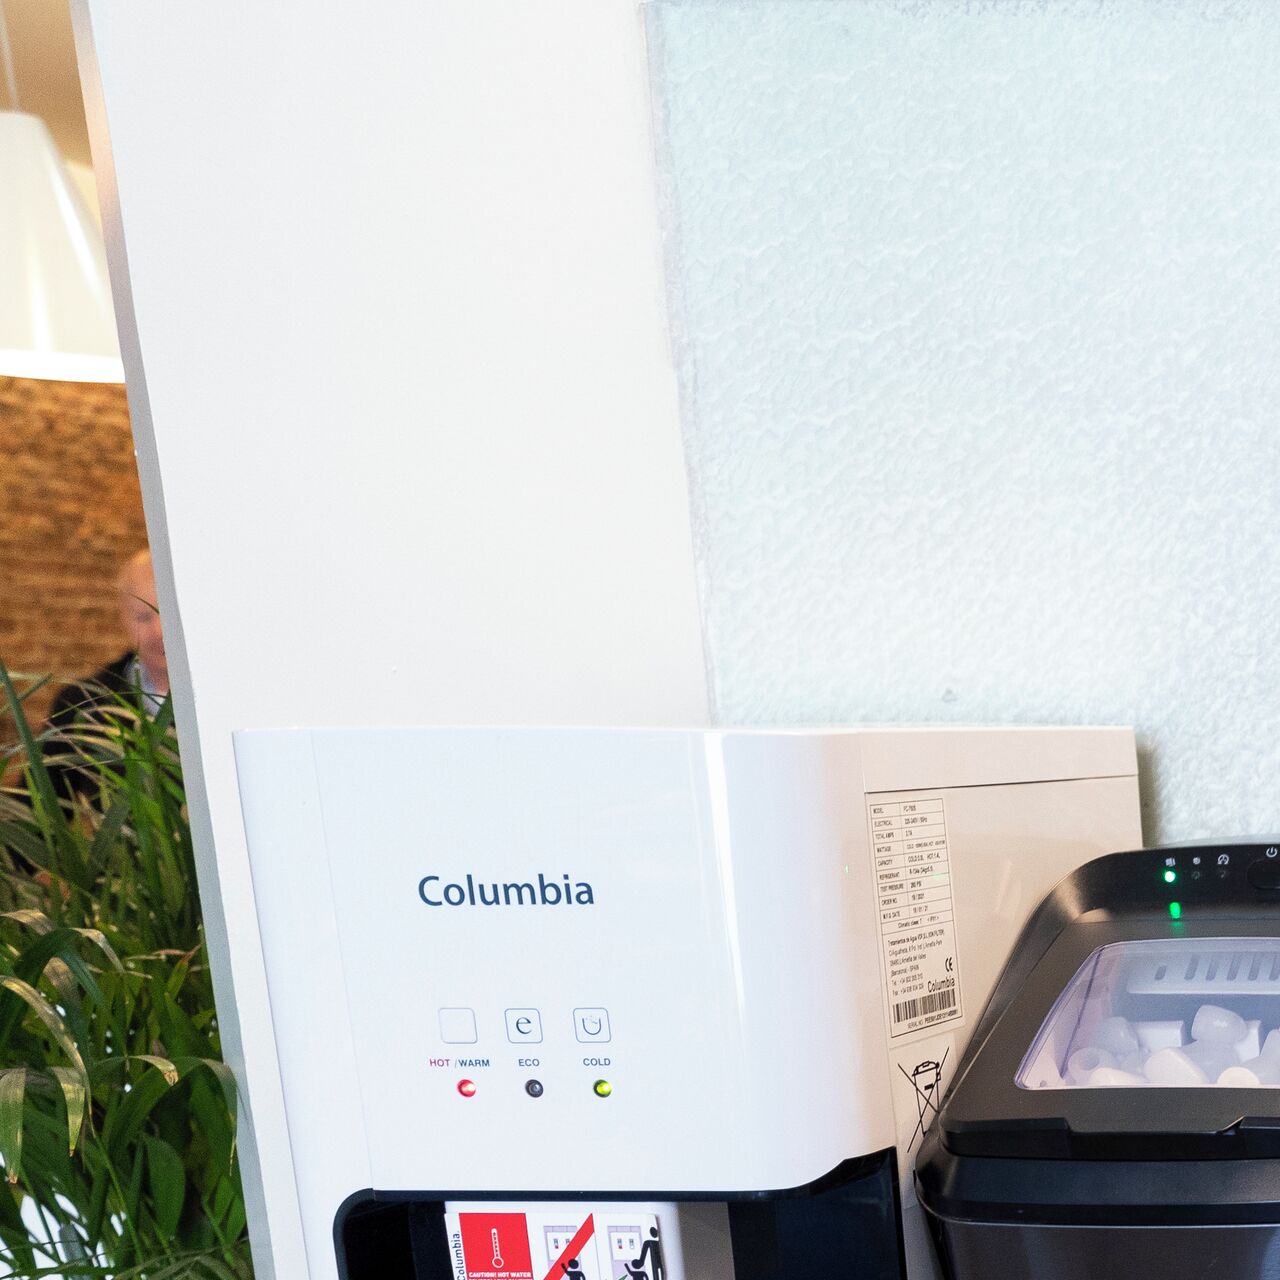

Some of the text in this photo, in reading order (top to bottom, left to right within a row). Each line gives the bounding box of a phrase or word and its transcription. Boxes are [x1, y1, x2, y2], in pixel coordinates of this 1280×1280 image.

[418, 873, 595, 906] Columbia
[430, 1058, 450, 1067] HOT
[518, 1058, 540, 1067] ECO
[582, 1057, 611, 1066] COLD
